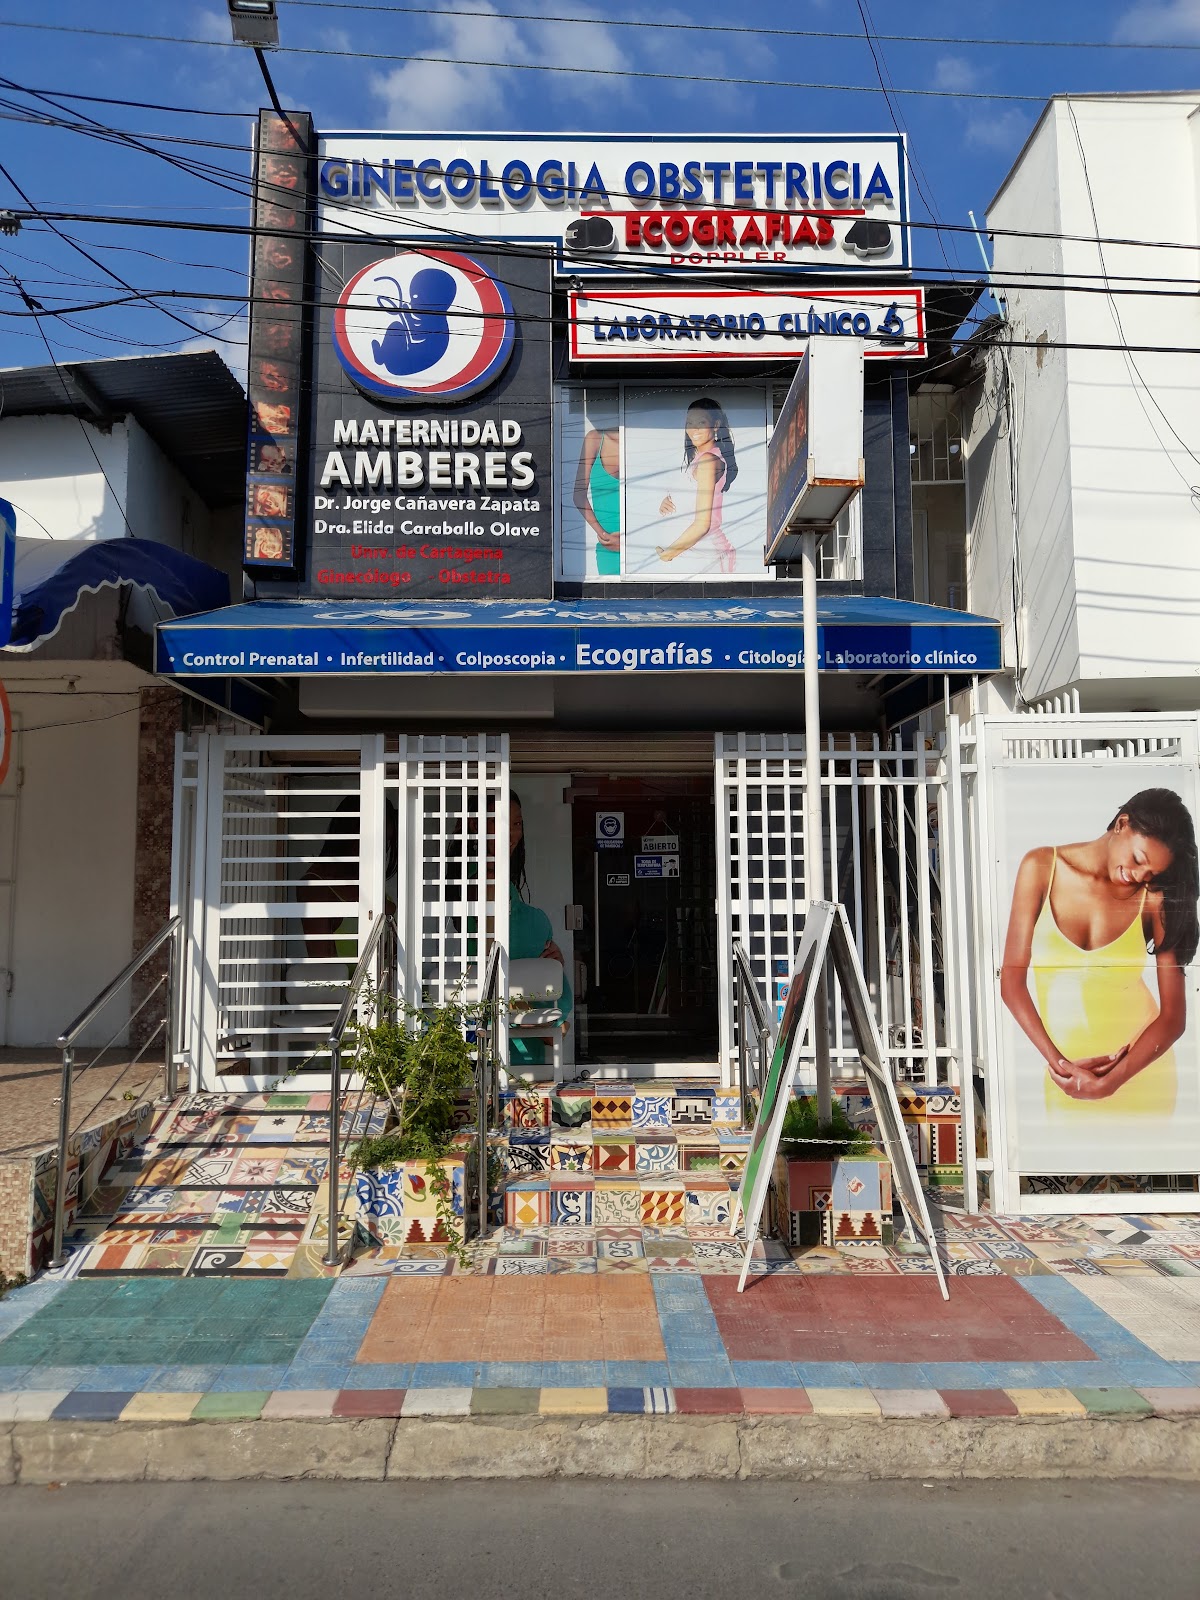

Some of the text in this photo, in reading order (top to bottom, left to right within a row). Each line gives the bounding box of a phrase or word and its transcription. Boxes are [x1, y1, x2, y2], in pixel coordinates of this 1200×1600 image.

[321, 157, 895, 205] GINECOLOGIA OBSTETRICIA
[625, 215, 836, 247] ECOGRAFIAS
[670, 251, 788, 265] DOPPLER
[594, 304, 872, 341] LABORATORIO CLÍNICO
[333, 419, 522, 447] MATERNIDAD
[319, 451, 535, 491] AMBERES
[314, 496, 541, 515] Dr. Jorge Cañavera Zapata
[400, 520, 486, 536] Caraballo
[490, 522, 541, 537] Olave
[351, 544, 504, 564] Univ. de Cartagena
[316, 568, 412, 588] Ginecólogo
[437, 568, 511, 585] Obstetra
[182, 642, 978, 671] Control Prenatal Infertilidad Colposcopia Ecografías Citologí Laboratorio clínico
[643, 843, 677, 851] ABIERTO
